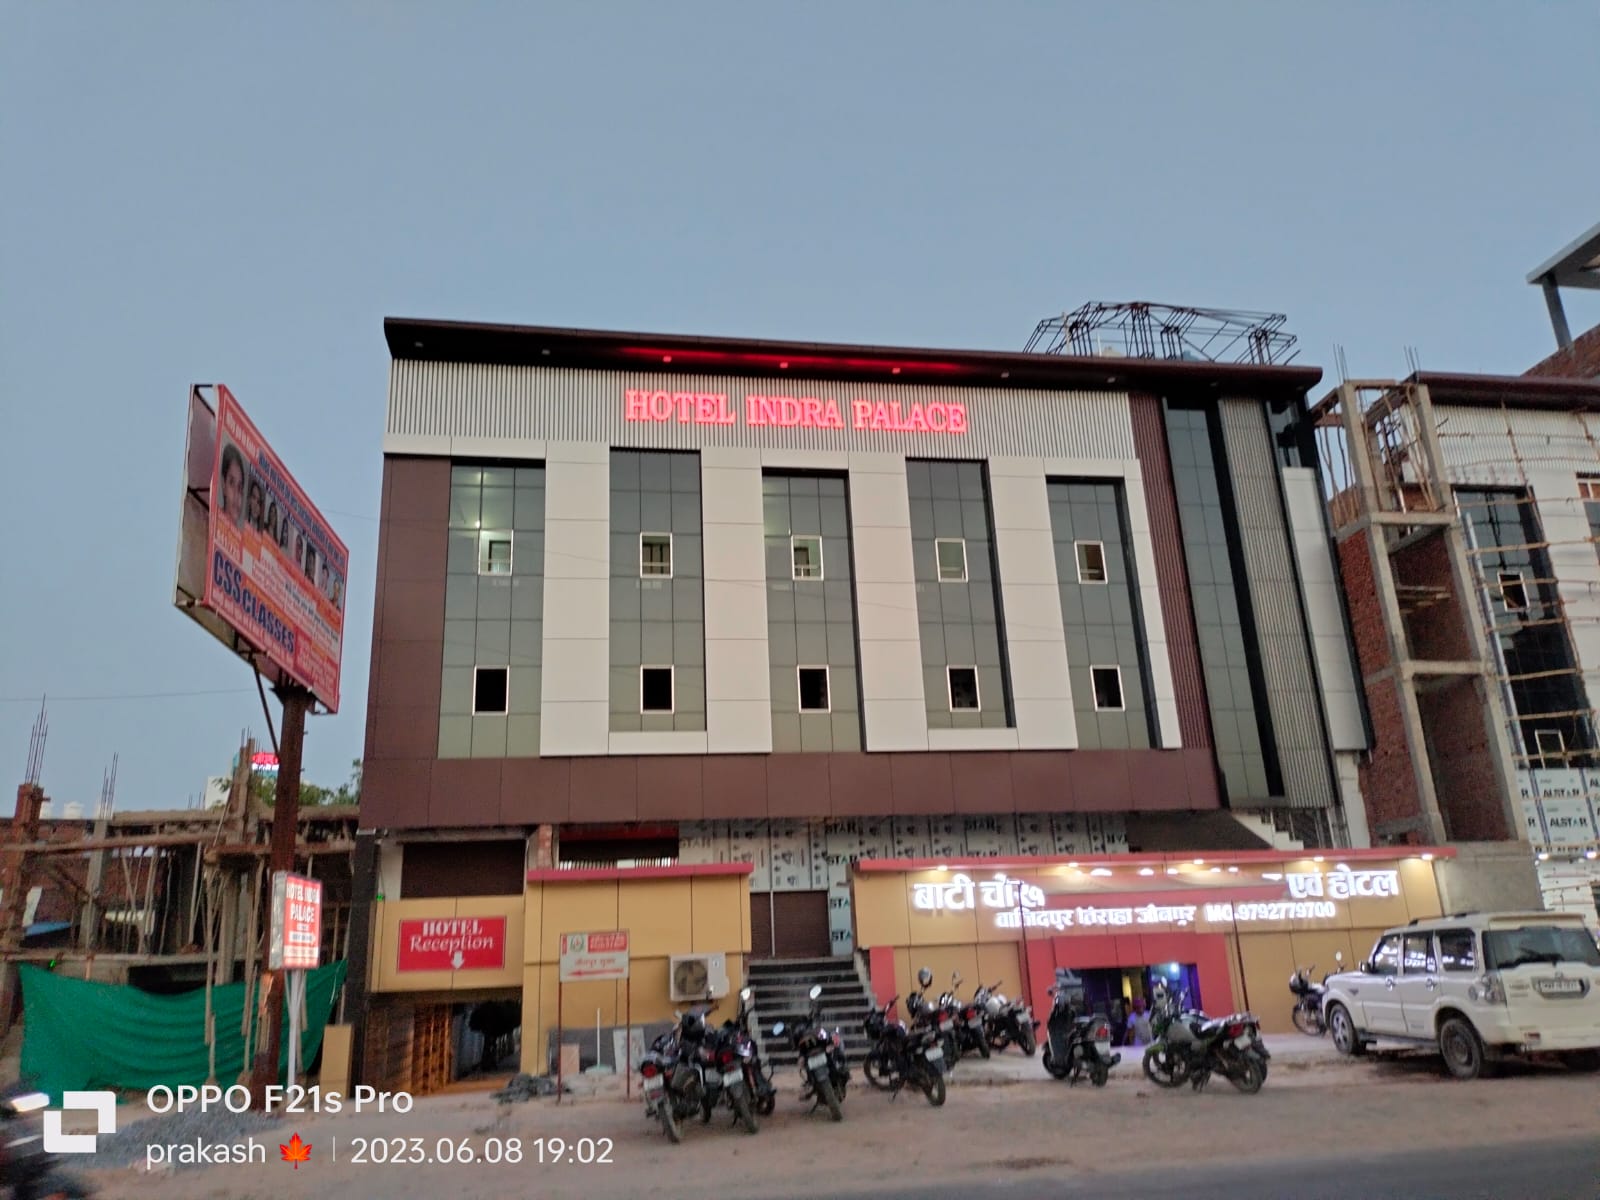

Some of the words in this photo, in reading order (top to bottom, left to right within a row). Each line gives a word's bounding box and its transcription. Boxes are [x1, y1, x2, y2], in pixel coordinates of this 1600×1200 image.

[625, 389, 737, 426] HOTEL
[746, 395, 845, 430] INDRA
[852, 400, 968, 434] PALACE
[214, 550, 241, 604] CSS
[286, 882, 304, 901] HOTEL
[913, 873, 976, 909] बाटी
[1286, 866, 1324, 899] एवं
[1326, 863, 1400, 899] होटल
[290, 903, 315, 923] PALACE
[422, 918, 483, 935] HOTEL
[409, 934, 495, 954] Reception
